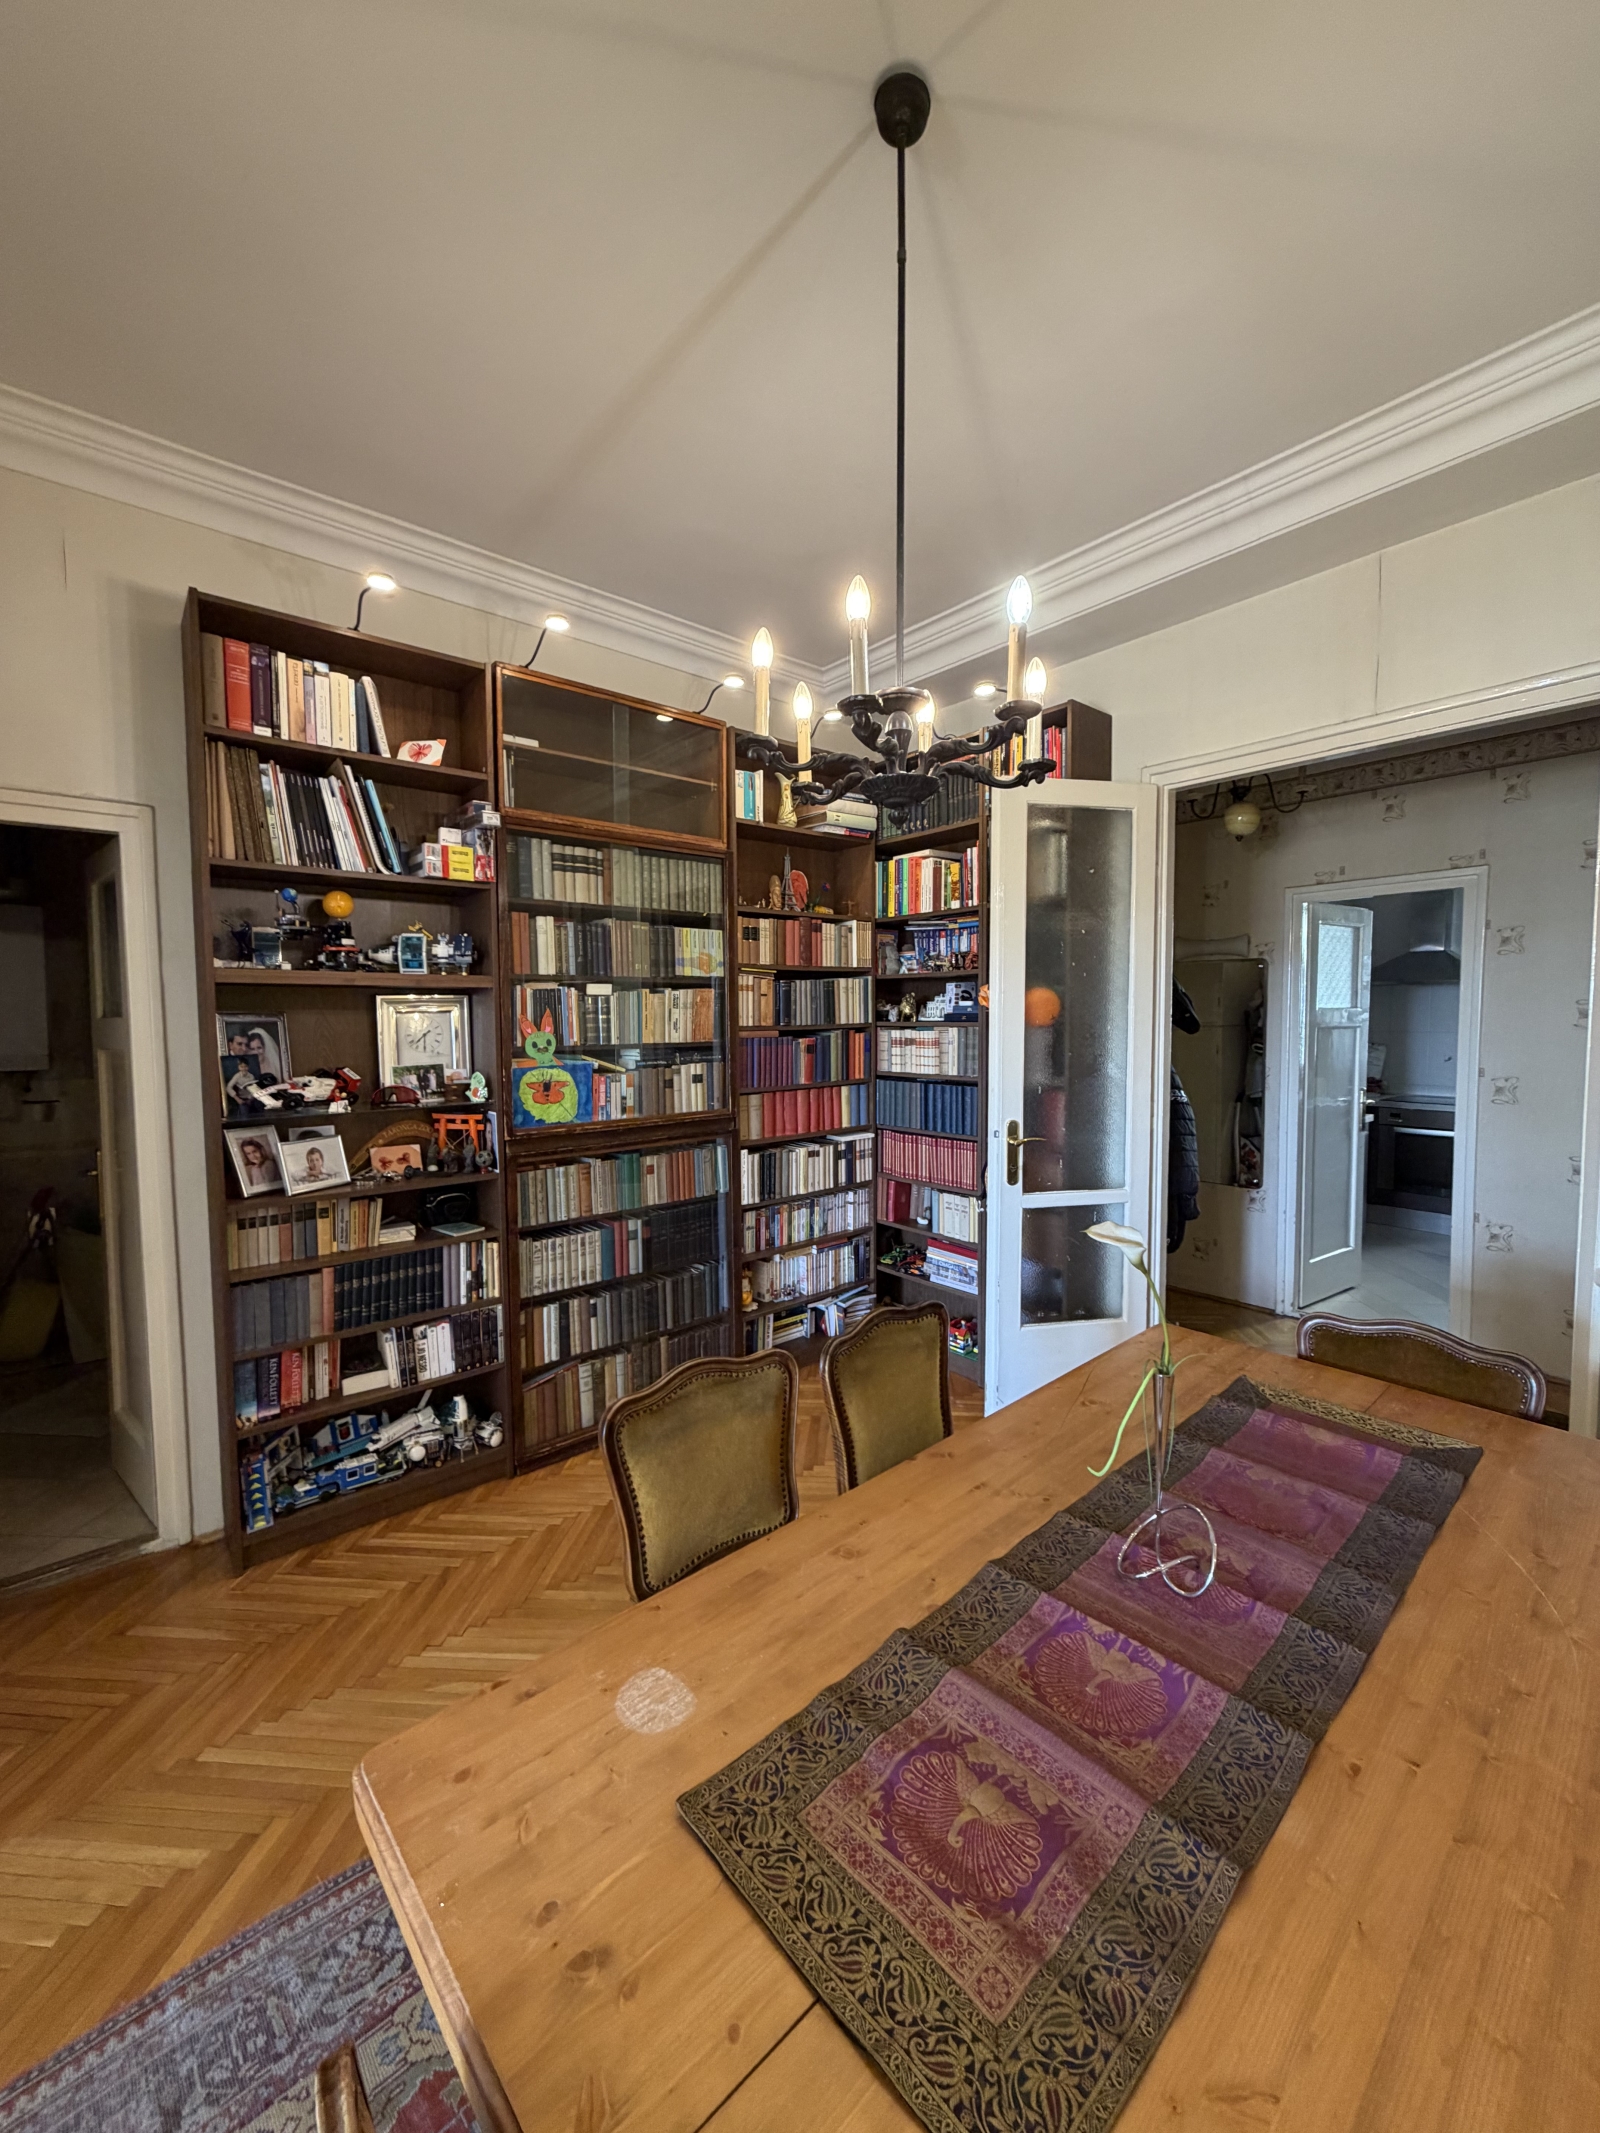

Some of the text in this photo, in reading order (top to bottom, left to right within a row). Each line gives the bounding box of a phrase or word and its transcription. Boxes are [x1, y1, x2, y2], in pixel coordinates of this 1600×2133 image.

[269, 1358, 278, 1405] KEN FOLLETT
[291, 1352, 300, 1399] KEN FOLLETT
